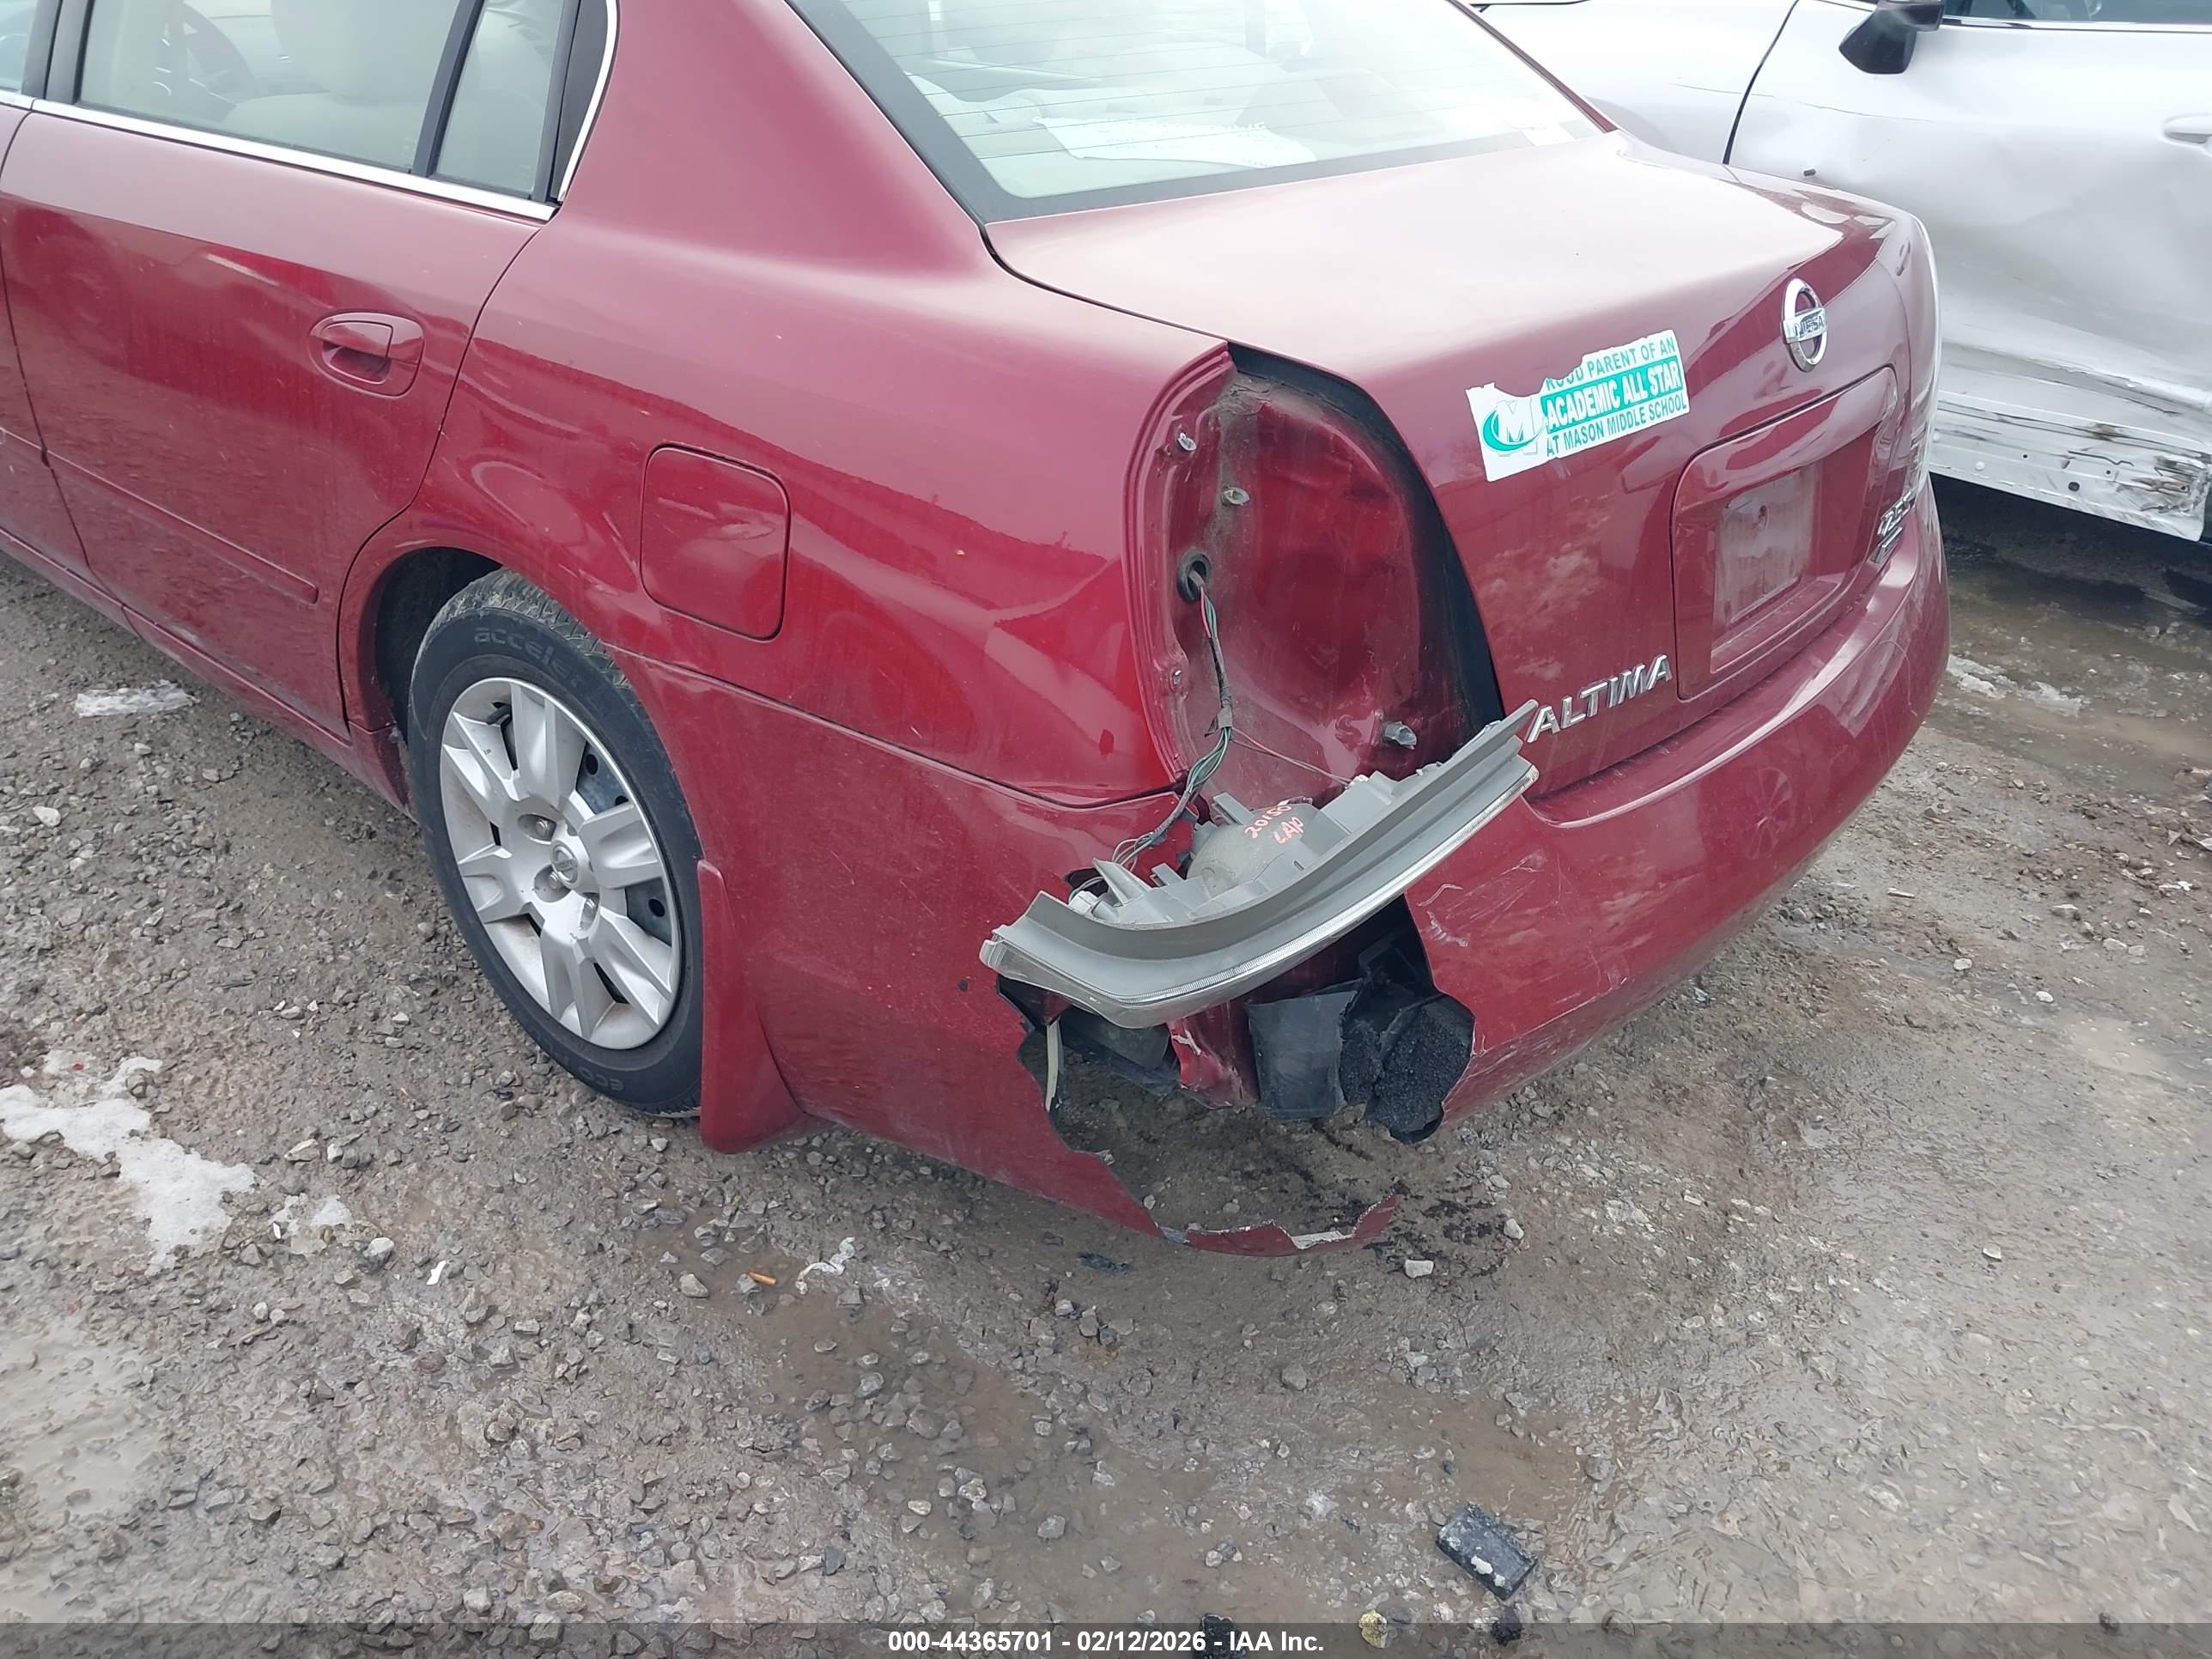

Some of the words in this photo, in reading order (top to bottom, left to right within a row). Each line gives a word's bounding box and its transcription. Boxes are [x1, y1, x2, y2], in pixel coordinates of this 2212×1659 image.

[1587, 348, 1638, 379] PARENT
[1641, 343, 1656, 361] OF
[1660, 337, 1676, 356] AN
[1546, 379, 1622, 430] ACADEMIC
[1621, 371, 1649, 406] ALL
[1647, 360, 1681, 398] STAR
[1547, 435, 1560, 457] AT
[1564, 420, 1605, 451] MASON
[1607, 406, 1647, 436] MIDDLE
[1648, 392, 1686, 422] SCHOOL
[1523, 653, 1673, 744] ALTIMA
